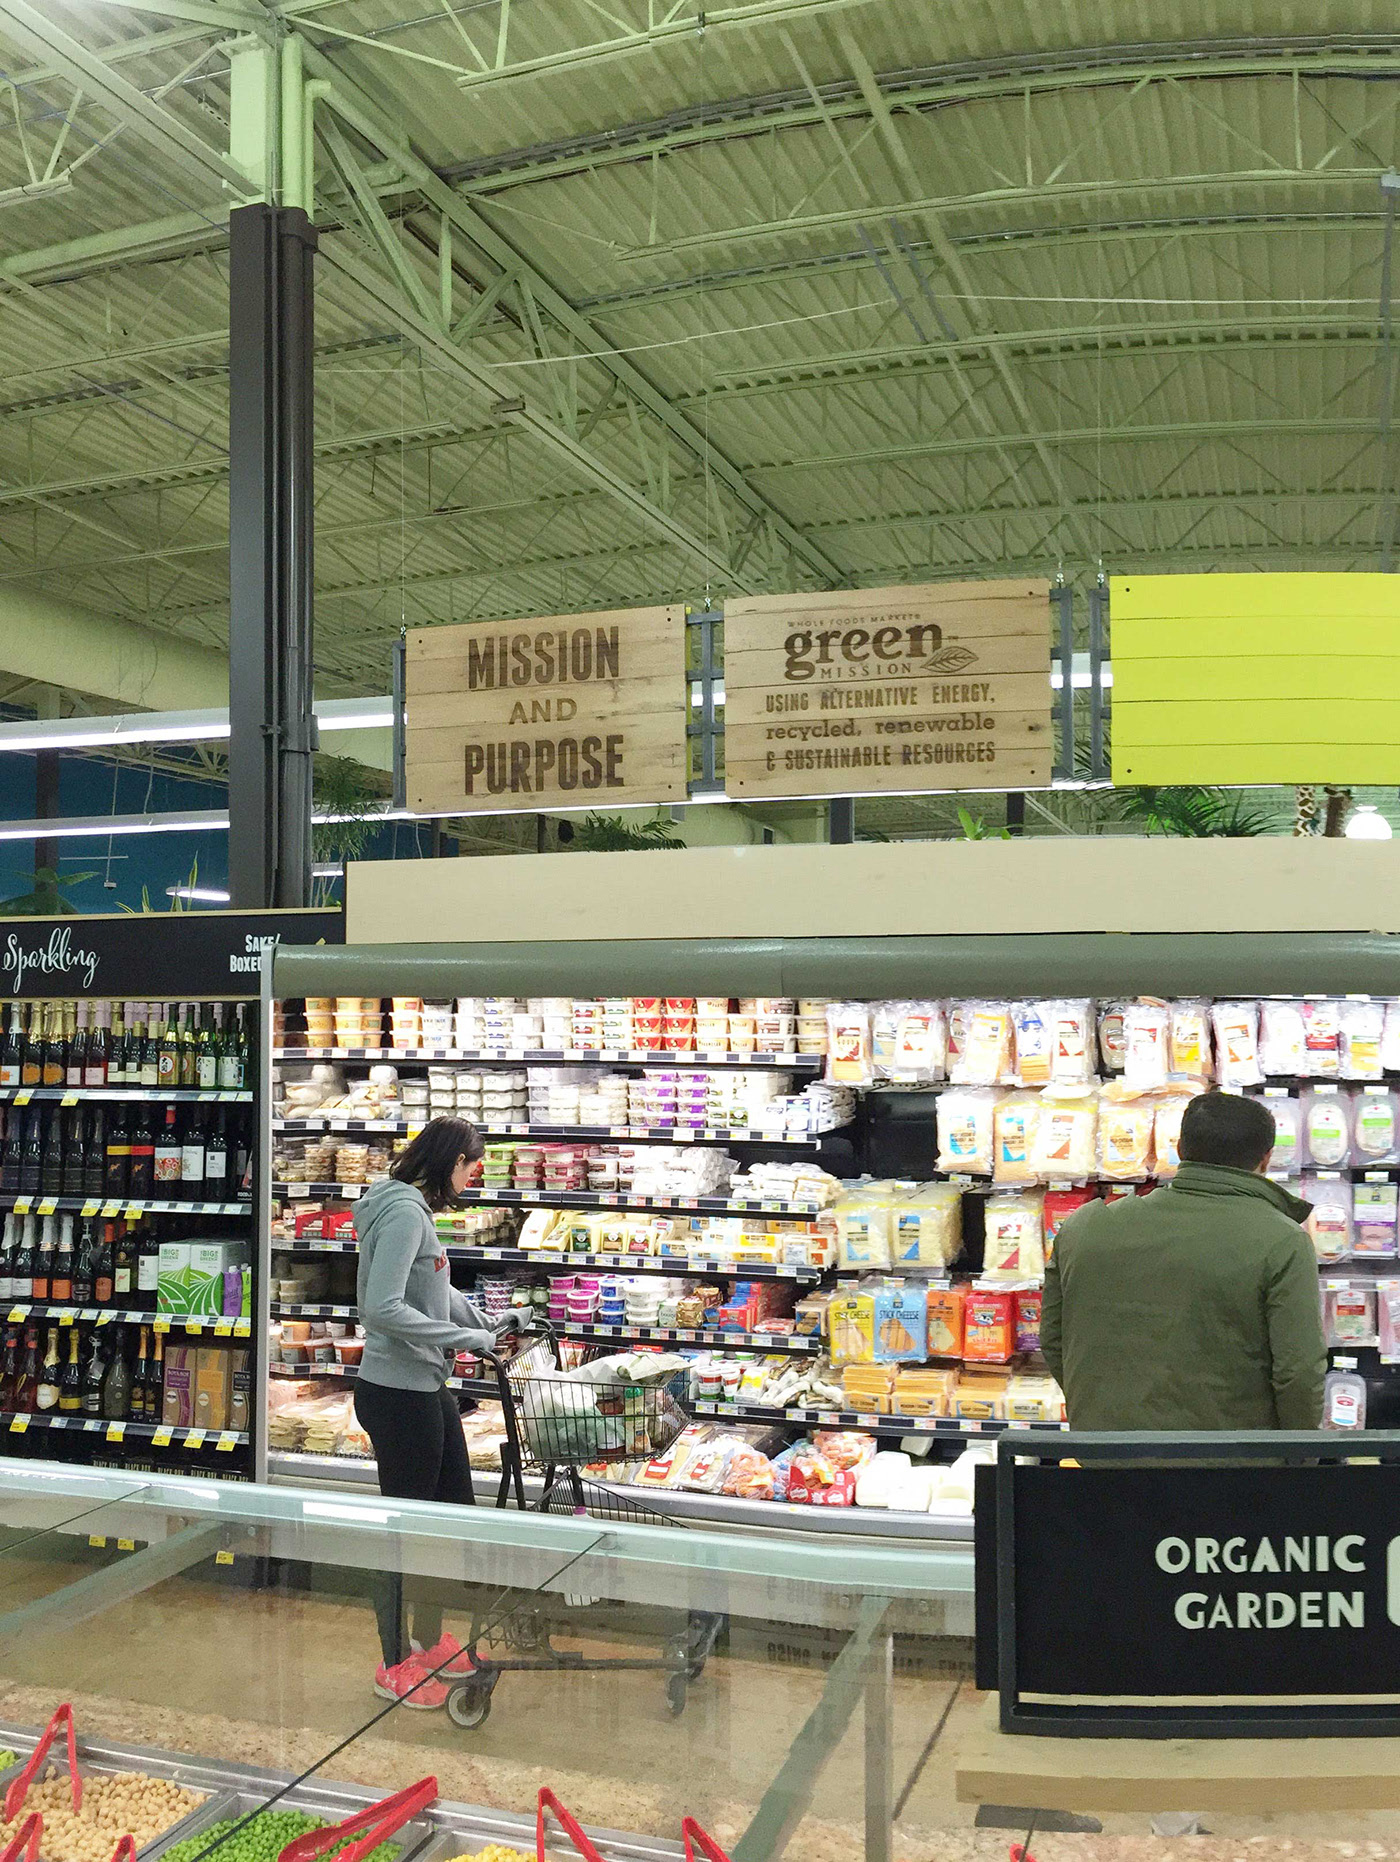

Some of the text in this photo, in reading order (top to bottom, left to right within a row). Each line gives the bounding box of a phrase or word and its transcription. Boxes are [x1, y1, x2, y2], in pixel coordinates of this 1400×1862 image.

[468, 626, 620, 690] MISSION
[784, 623, 942, 680] green
[820, 663, 912, 679] MISSION
[508, 697, 577, 725] AND
[766, 682, 996, 713] USING ALTERNATIVE ENERGY,
[766, 713, 995, 741] recycled, renewable
[465, 735, 625, 796] PURPOSE
[785, 745, 892, 771] SUSTAINABLE
[902, 741, 996, 765] RESOURCES
[2, 926, 100, 994] Sparkling
[1154, 1535, 1366, 1574] ORGANIC
[1175, 1592, 1365, 1630] GARDEN
